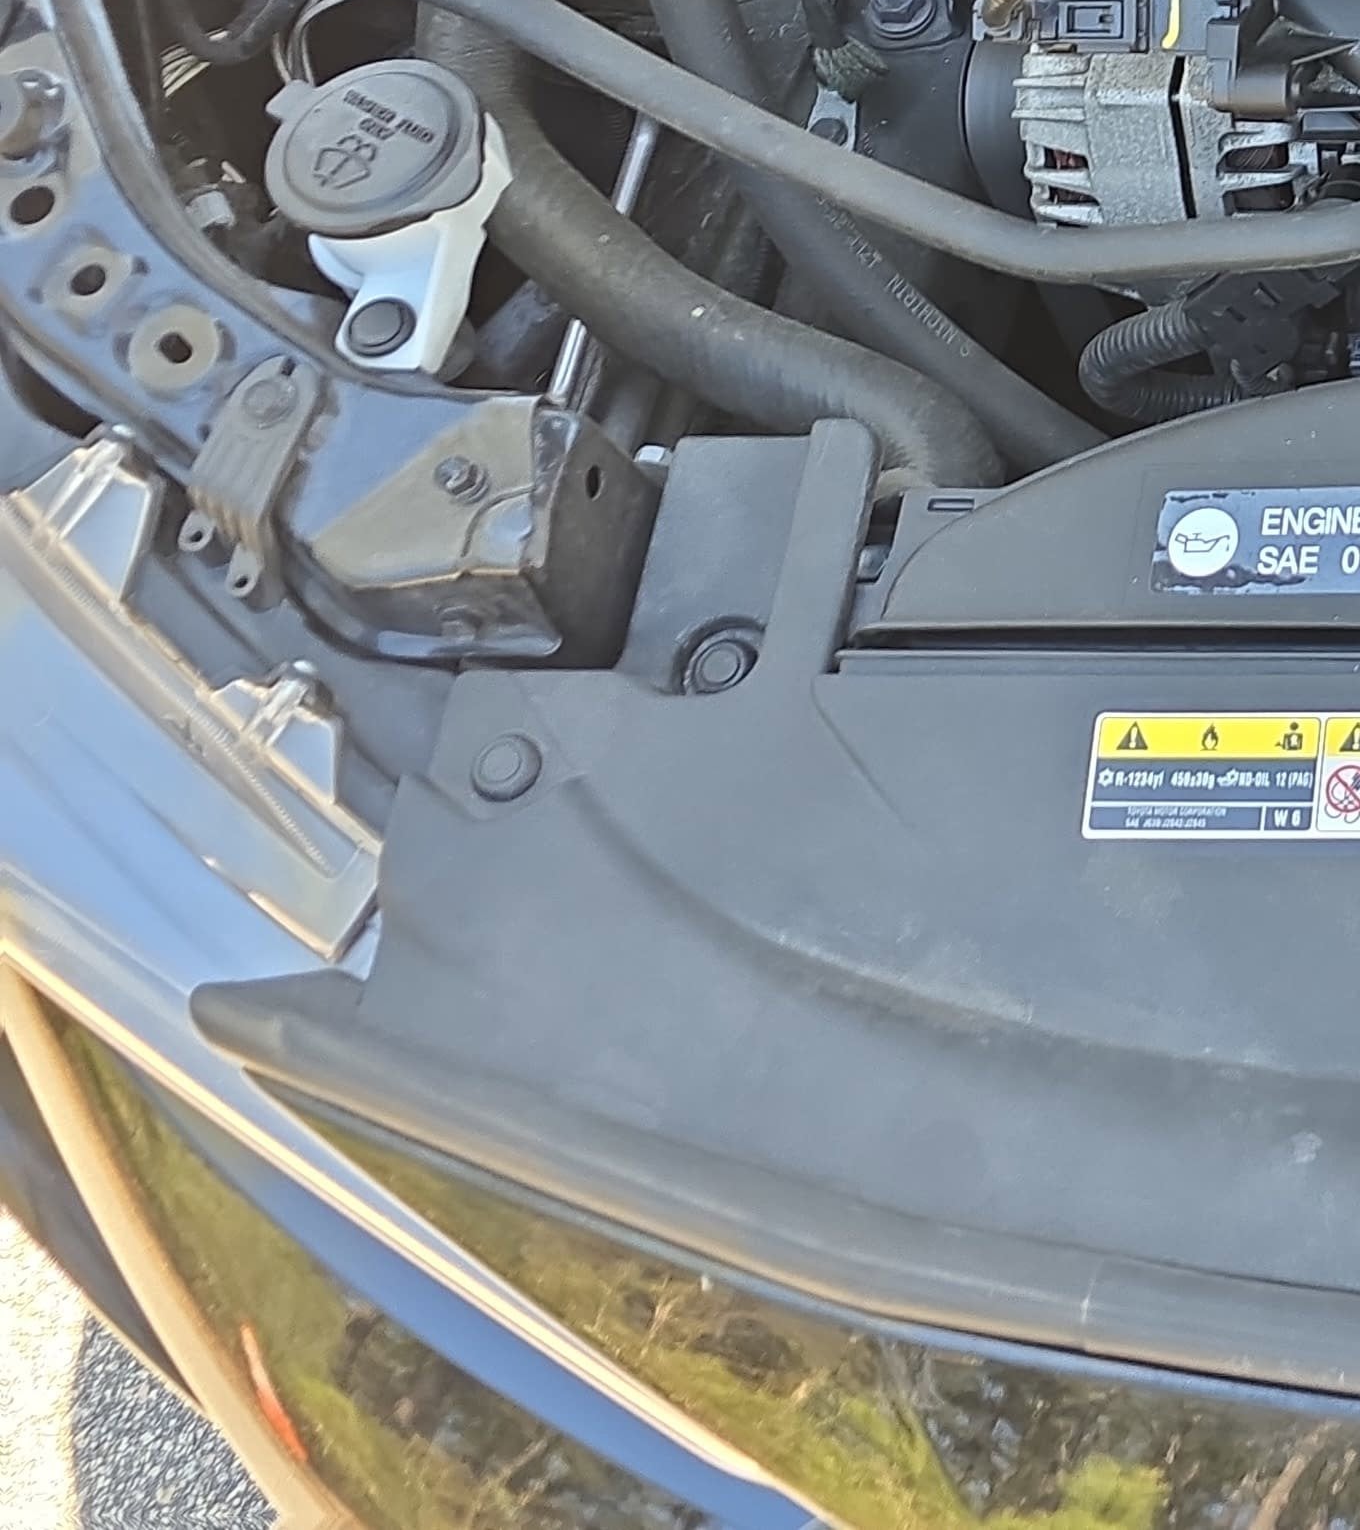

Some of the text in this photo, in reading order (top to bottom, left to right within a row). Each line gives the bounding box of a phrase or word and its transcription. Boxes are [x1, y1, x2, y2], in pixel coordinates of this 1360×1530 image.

[1257, 545, 1320, 575] SAE
[1276, 771, 1287, 787] 12
[1274, 810, 1288, 827] W
